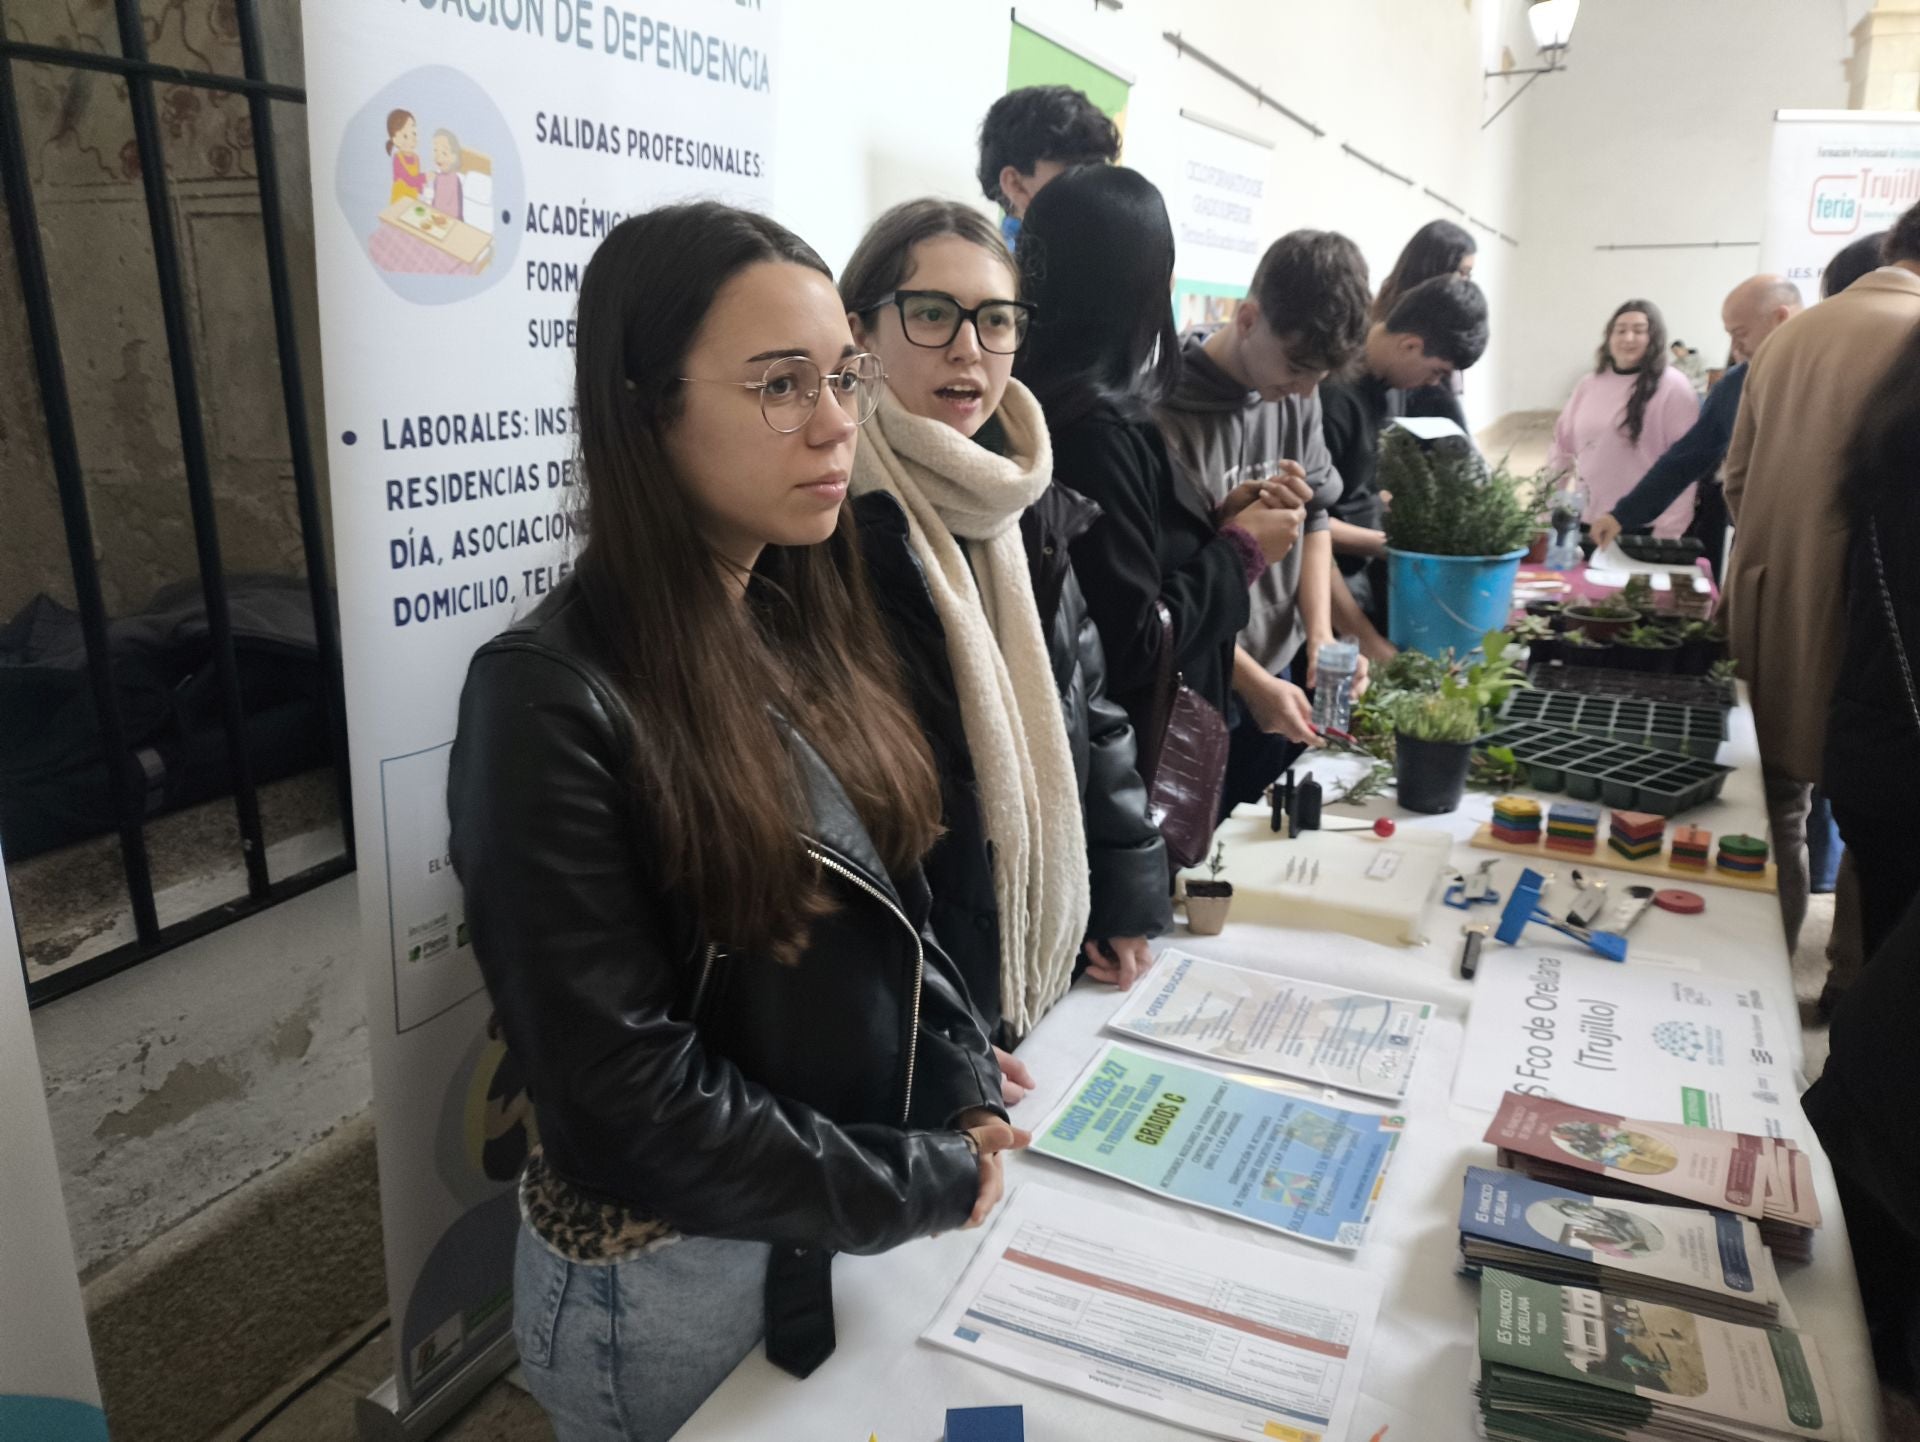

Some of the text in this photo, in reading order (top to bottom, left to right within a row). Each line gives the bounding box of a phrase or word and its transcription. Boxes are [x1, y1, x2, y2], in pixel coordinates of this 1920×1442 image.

[554, 0, 594, 50] DE
[603, 6, 770, 93] DEPENDENCIA
[536, 111, 766, 179] SALIDAS PROFESIONALES:
[526, 198, 630, 239] ACADÉMIC
[1816, 192, 1855, 219] feria
[382, 409, 529, 450] LABORALES:
[386, 459, 574, 511] RESIDENCIAS DE
[390, 526, 444, 570] DÍA,
[393, 575, 517, 628] DOMICILIO,
[428, 858, 441, 874] EL
[1146, 988, 1174, 1018] OFERTA
[1163, 957, 1193, 994] EDUCATIVA
[1525, 957, 1562, 1012] Orellana
[1521, 1016, 1556, 1042] de
[1572, 998, 1622, 1072] (Trujillo)
[1515, 1045, 1552, 1081] Fco
[1051, 1059, 1128, 1142] CURSO 2026-27
[1134, 1093, 1187, 1146] GRADOS C
[1497, 1288, 1513, 1345] IES FRANCISCO
[1517, 1296, 1531, 1346] DE ORELLANA
